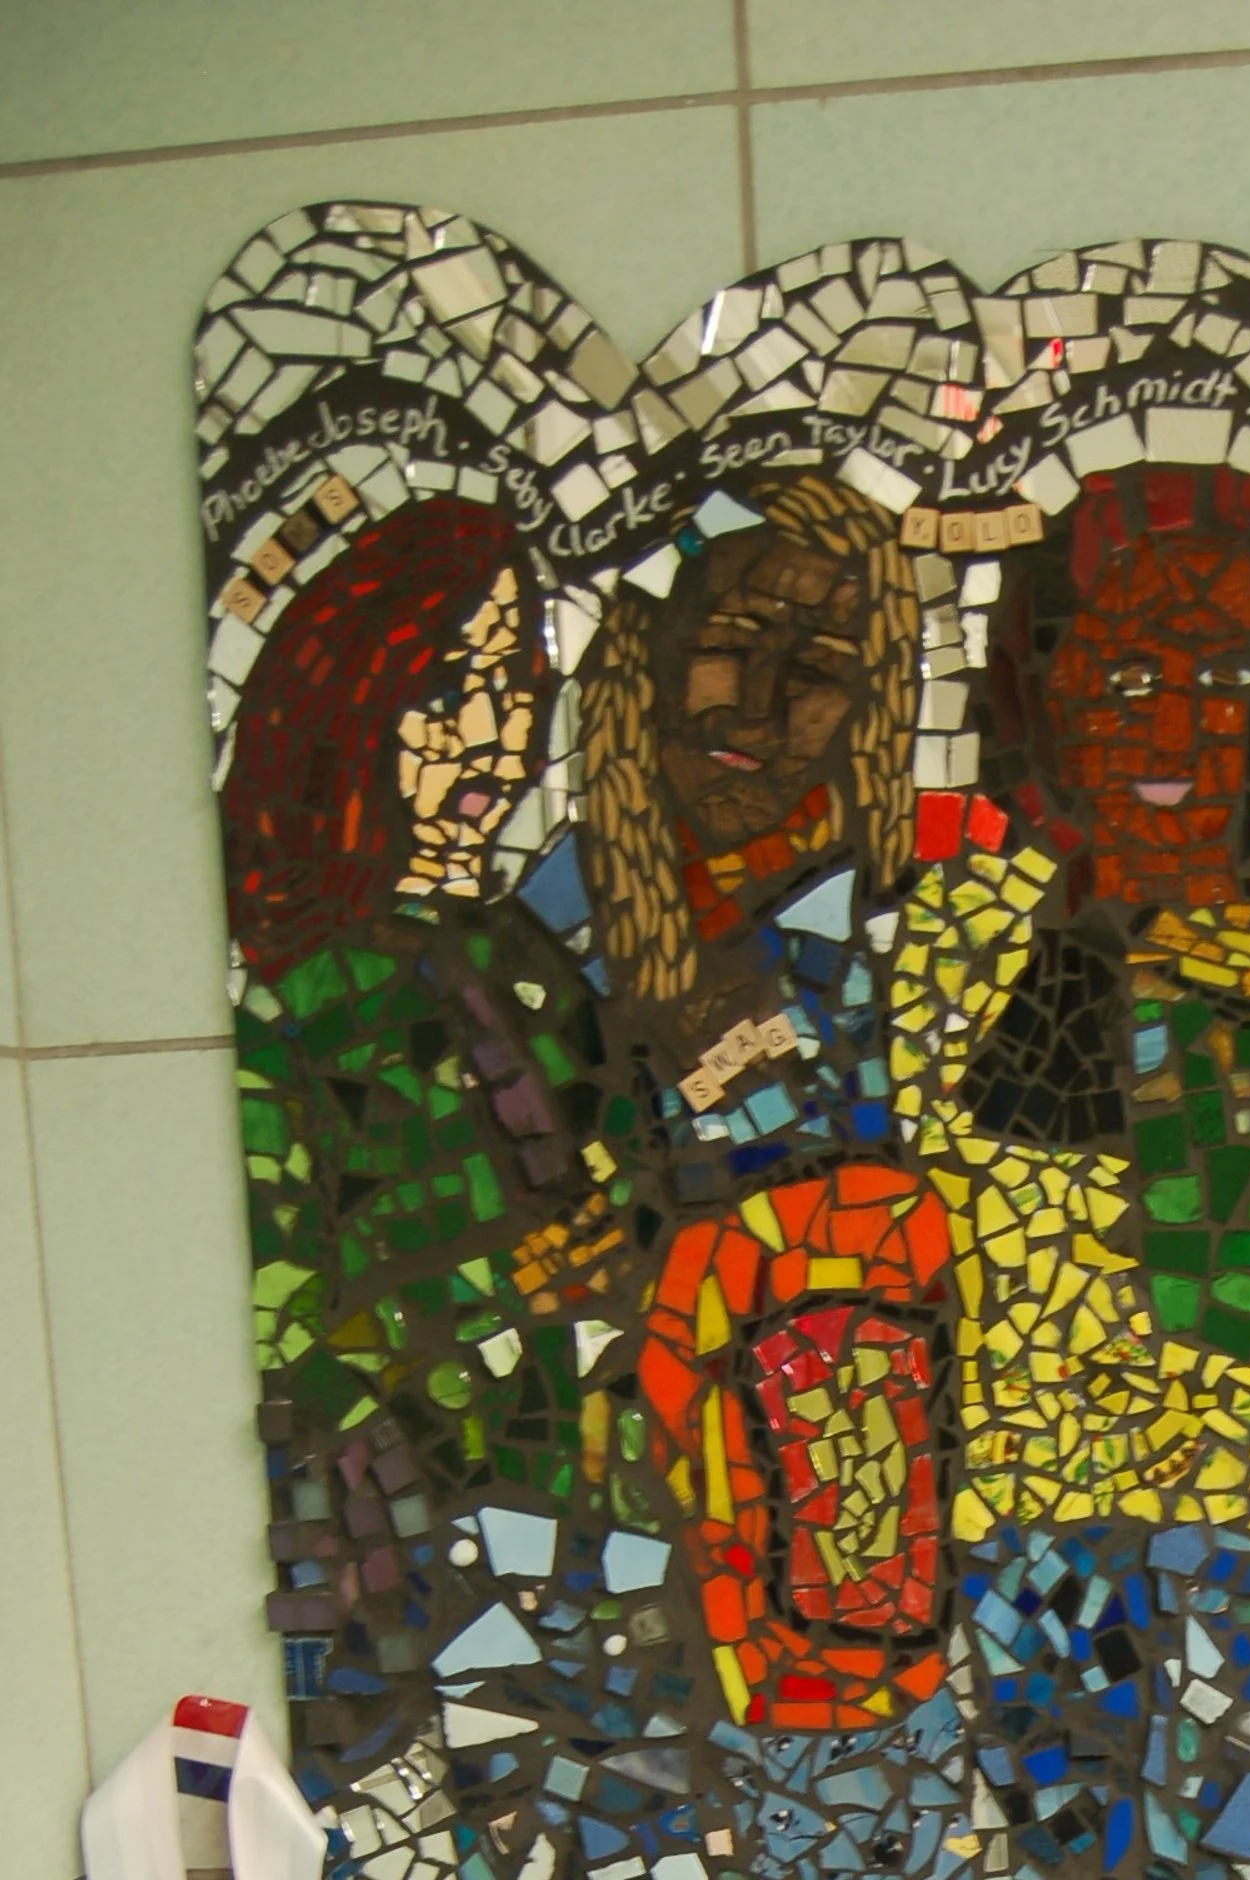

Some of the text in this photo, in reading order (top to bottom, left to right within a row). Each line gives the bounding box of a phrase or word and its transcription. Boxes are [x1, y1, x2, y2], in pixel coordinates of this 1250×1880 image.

[307, 395, 448, 457] Joseph
[803, 417, 925, 467] Taylor
[939, 370, 1238, 500] Lucy Schmidt
[549, 482, 674, 556] Clarke
[911, 513, 1031, 541] YOLO
[690, 1028, 786, 1098] SWAG
